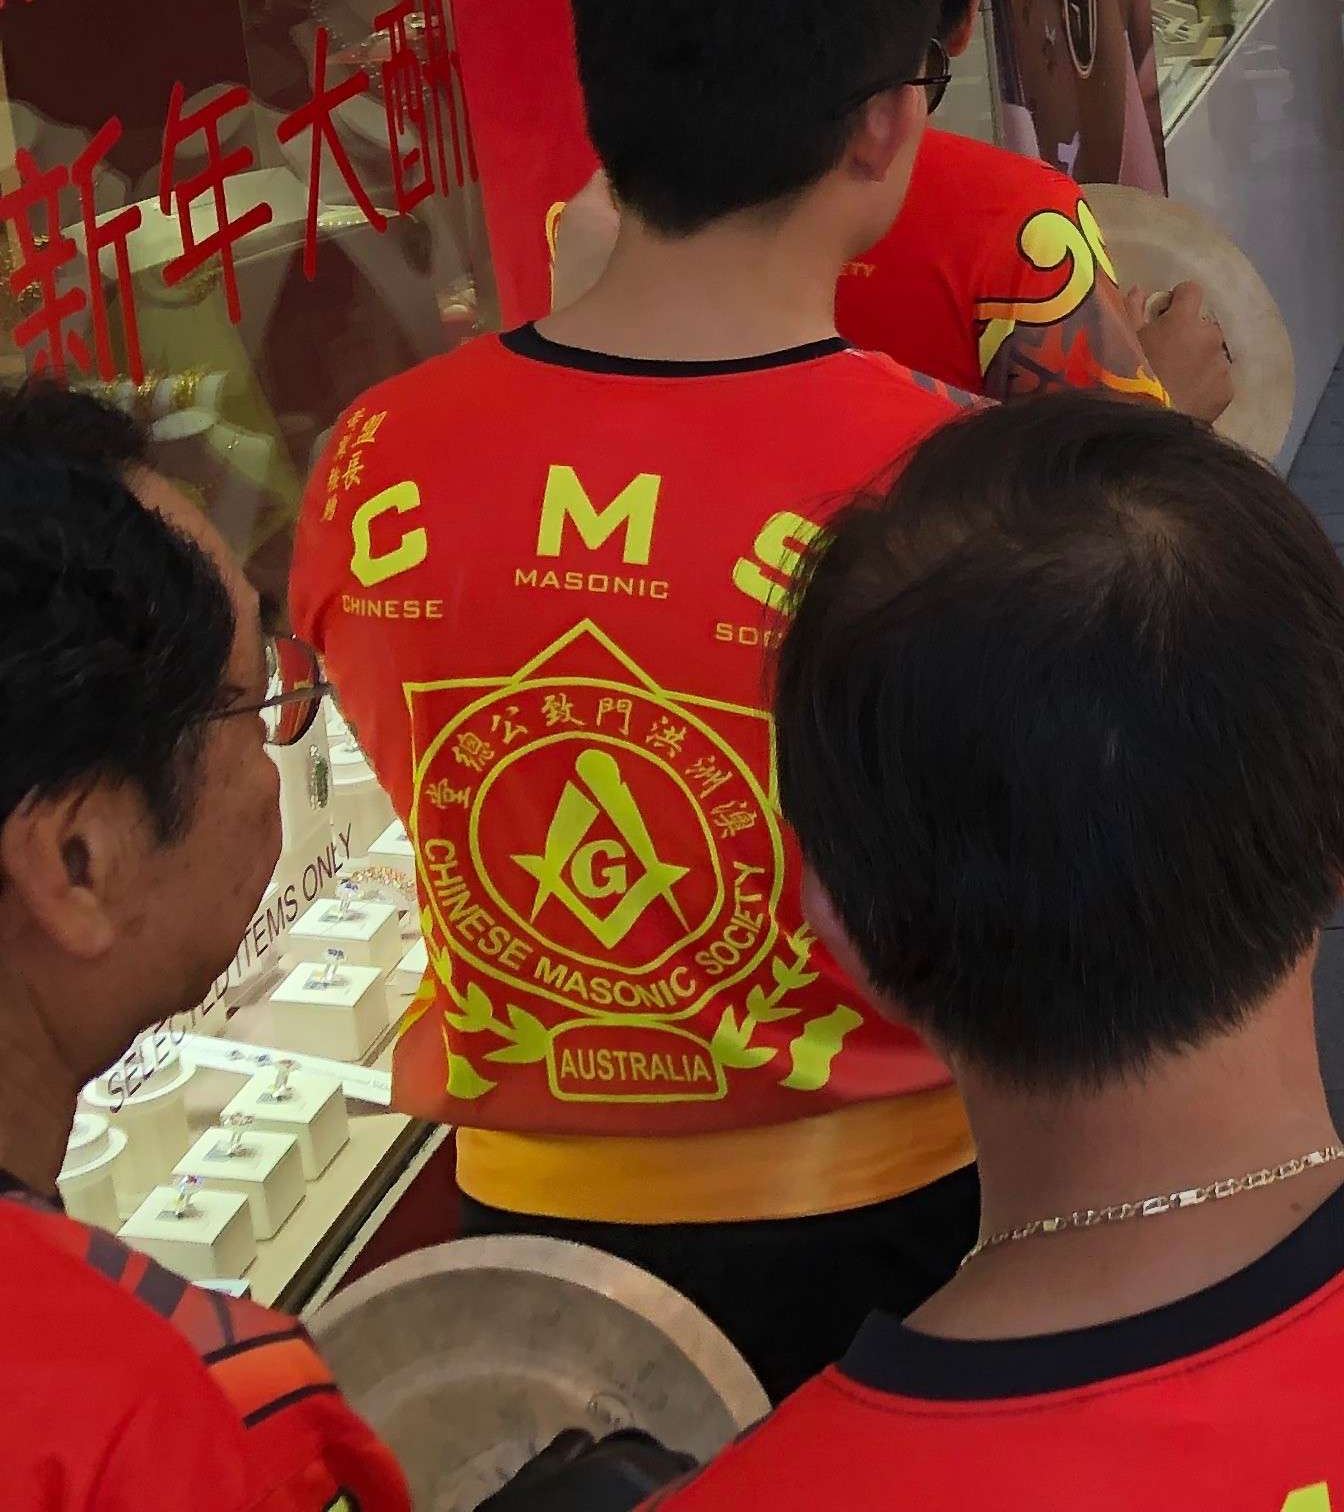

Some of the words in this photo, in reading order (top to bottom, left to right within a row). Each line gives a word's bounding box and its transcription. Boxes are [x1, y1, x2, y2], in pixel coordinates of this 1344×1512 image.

[350, 480, 428, 587] C
[536, 464, 662, 566] M
[341, 594, 444, 620] CHINESE
[514, 567, 670, 600] MASONIC
[301, 822, 353, 901] ONLY
[571, 839, 629, 900] G
[423, 838, 534, 971] CHINESE
[534, 954, 698, 1009] MASONIC
[695, 860, 766, 976] SOCIETY
[560, 1048, 713, 1083] AUSTRALIA
